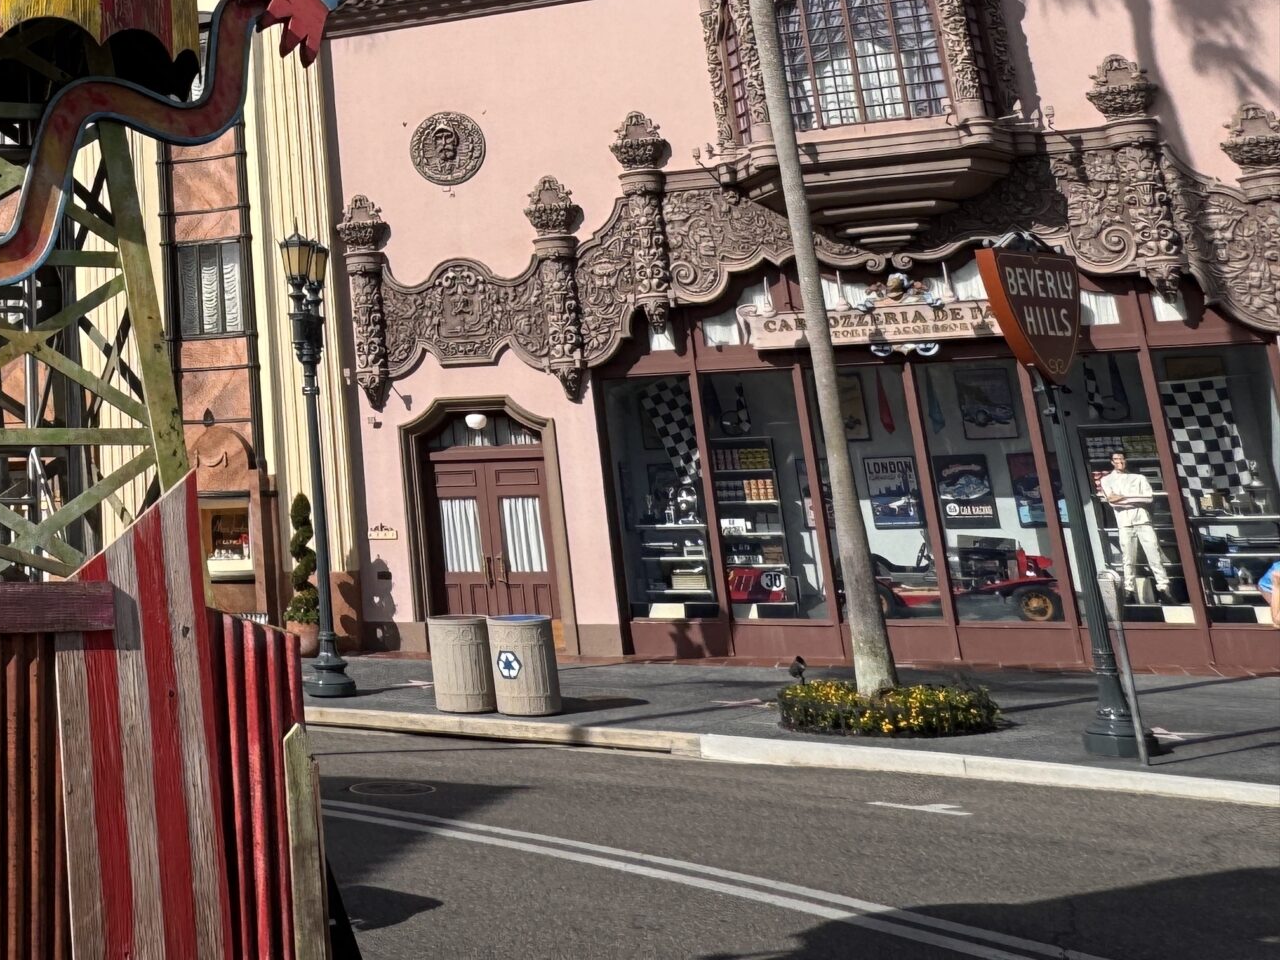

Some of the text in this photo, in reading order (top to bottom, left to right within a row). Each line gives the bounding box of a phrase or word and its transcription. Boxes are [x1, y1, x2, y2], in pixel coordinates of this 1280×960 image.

[1005, 266, 1073, 300] BEVERLY
[763, 309, 927, 333] CAROZZERIA
[1023, 305, 1072, 337] HILLS
[866, 460, 913, 475] LONDON
[765, 573, 782, 589] 30
